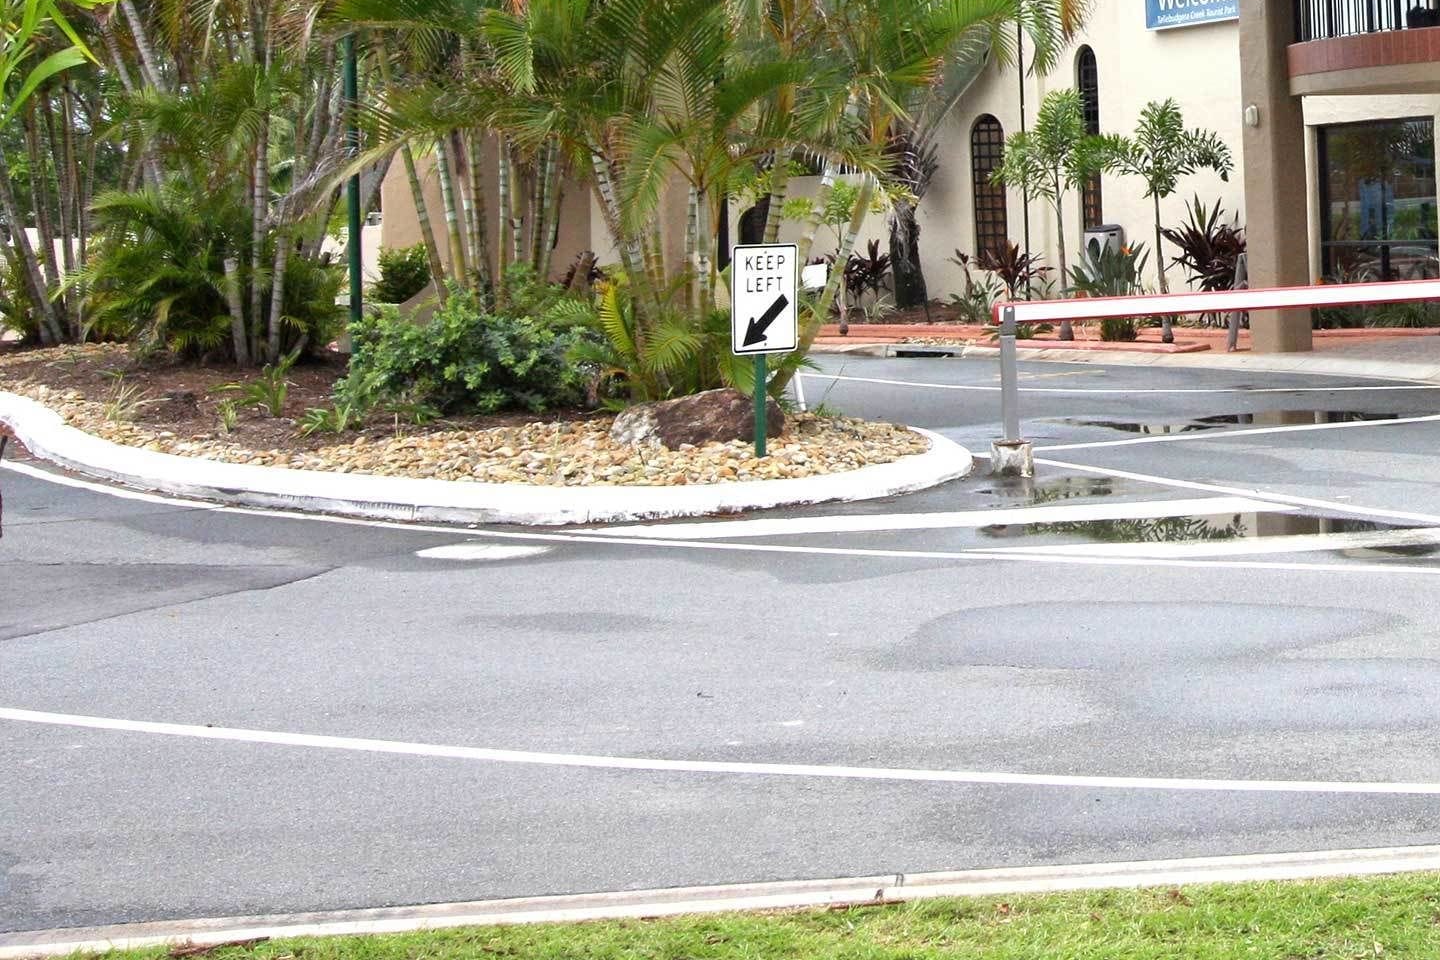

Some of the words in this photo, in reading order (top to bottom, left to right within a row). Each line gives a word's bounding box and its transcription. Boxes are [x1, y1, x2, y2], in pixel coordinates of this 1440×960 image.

[1206, 8, 1224, 17] Tourist
[1224, 6, 1236, 15] Park
[745, 255, 785, 271] KEEP
[746, 276, 783, 293] LEFT
